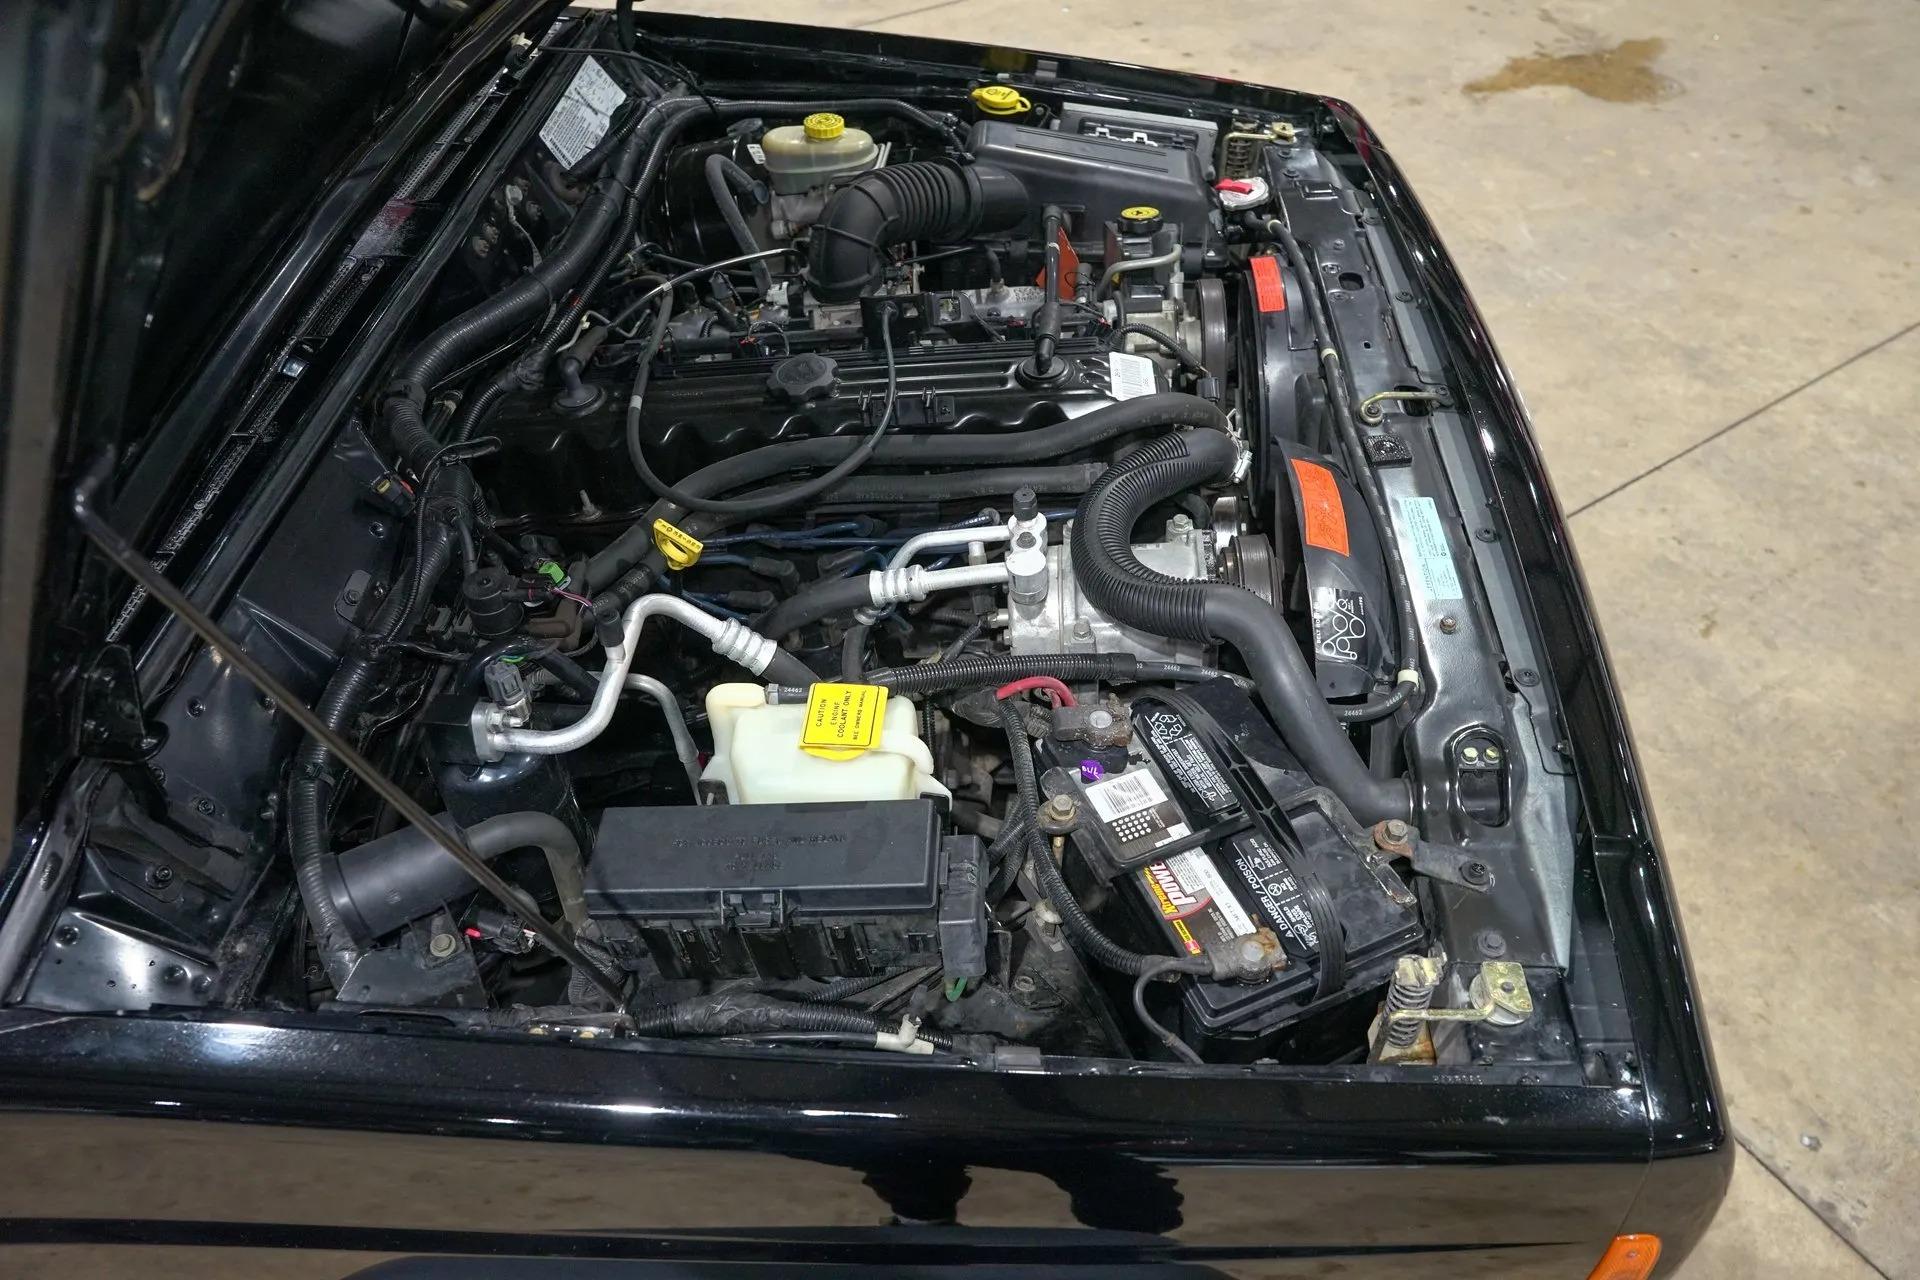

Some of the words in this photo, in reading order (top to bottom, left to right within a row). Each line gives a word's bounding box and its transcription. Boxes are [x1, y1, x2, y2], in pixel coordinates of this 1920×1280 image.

[1164, 664, 1180, 672] 24462
[815, 698, 827, 728] CAUTION
[830, 702, 840, 726] ENGINE
[837, 708, 849, 738] COOLANT
[1344, 708, 1363, 716] 24462
[1149, 859, 1198, 906] POWE
[1234, 857, 1260, 888] POISON
[1151, 882, 1178, 914] Xtreme
[1259, 895, 1288, 930] DANGER
